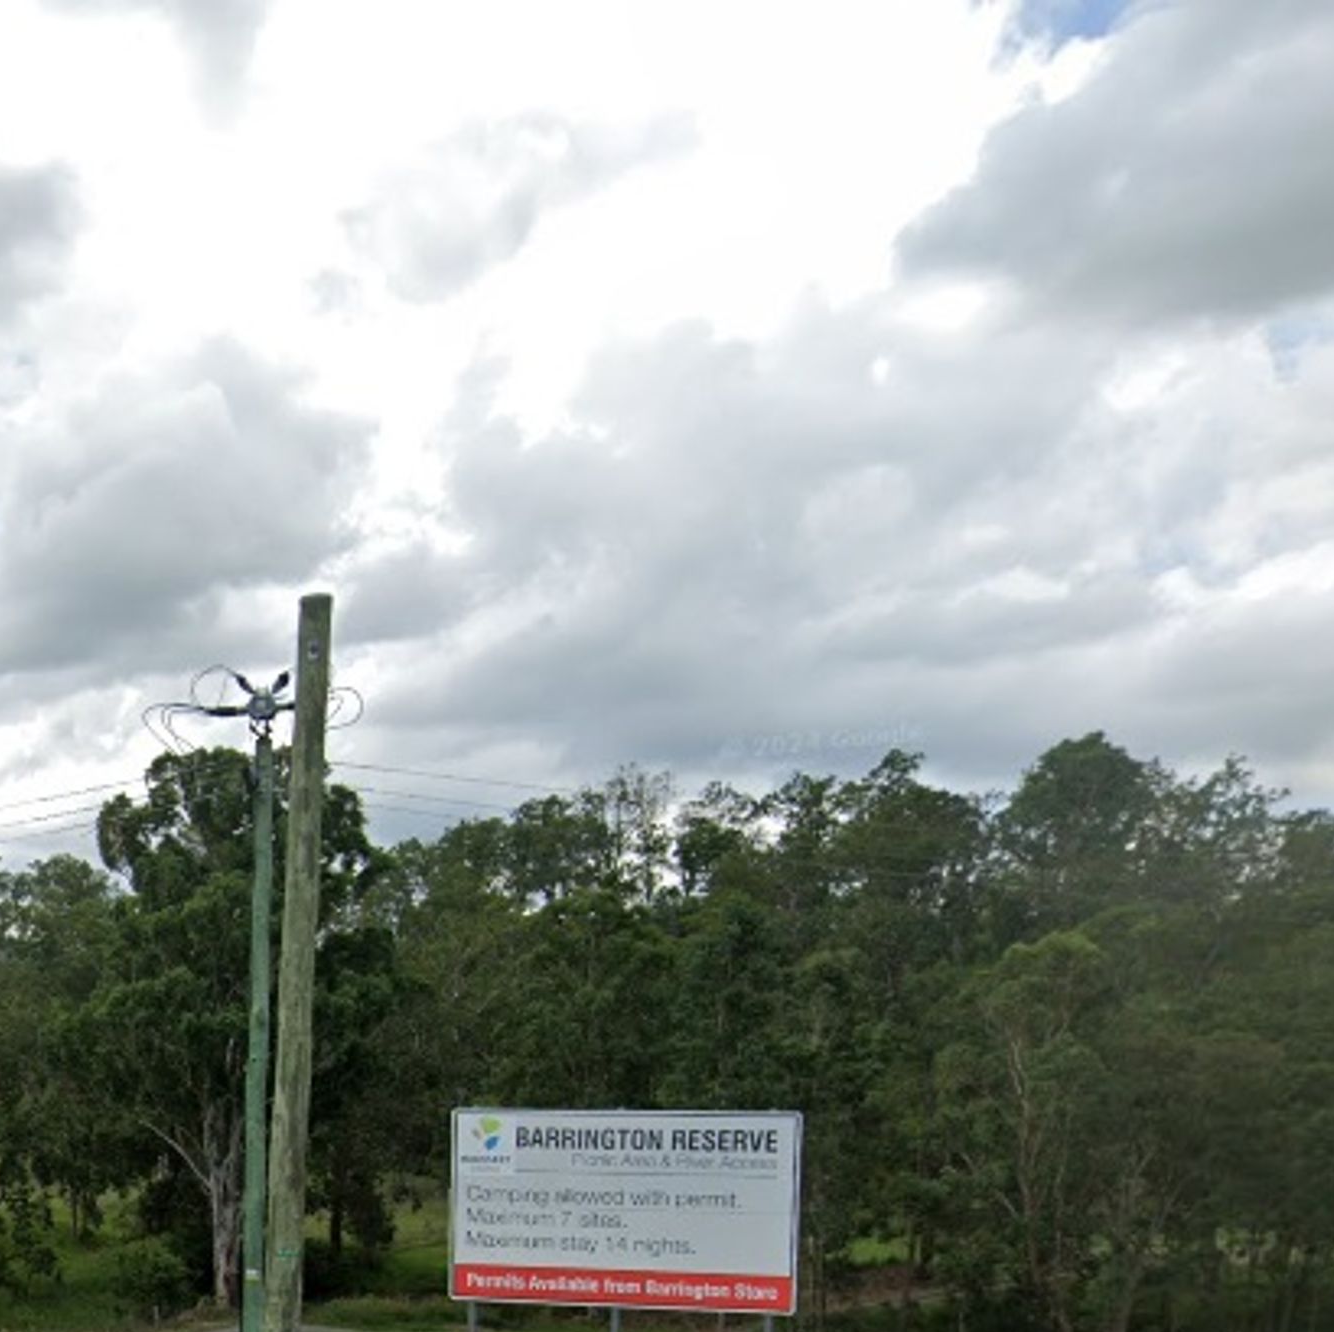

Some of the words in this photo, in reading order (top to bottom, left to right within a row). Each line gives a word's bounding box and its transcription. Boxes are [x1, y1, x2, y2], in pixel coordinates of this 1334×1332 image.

[515, 1126, 663, 1151] BARRINGTON
[671, 1128, 779, 1153] RESERVE
[466, 1184, 549, 1209] Camping
[553, 1188, 624, 1206] allowed
[629, 1189, 671, 1207] with
[674, 1191, 742, 1210] permit.
[466, 1206, 555, 1226] Maximum
[580, 1210, 628, 1229] sites.
[466, 1229, 555, 1249] Maximum
[560, 1234, 598, 1254] stay
[631, 1237, 697, 1258] nights.
[466, 1271, 525, 1291] Permits
[528, 1274, 599, 1293] Available
[603, 1277, 641, 1295] from
[645, 1278, 731, 1301] Barrington
[733, 1281, 779, 1302] Store
